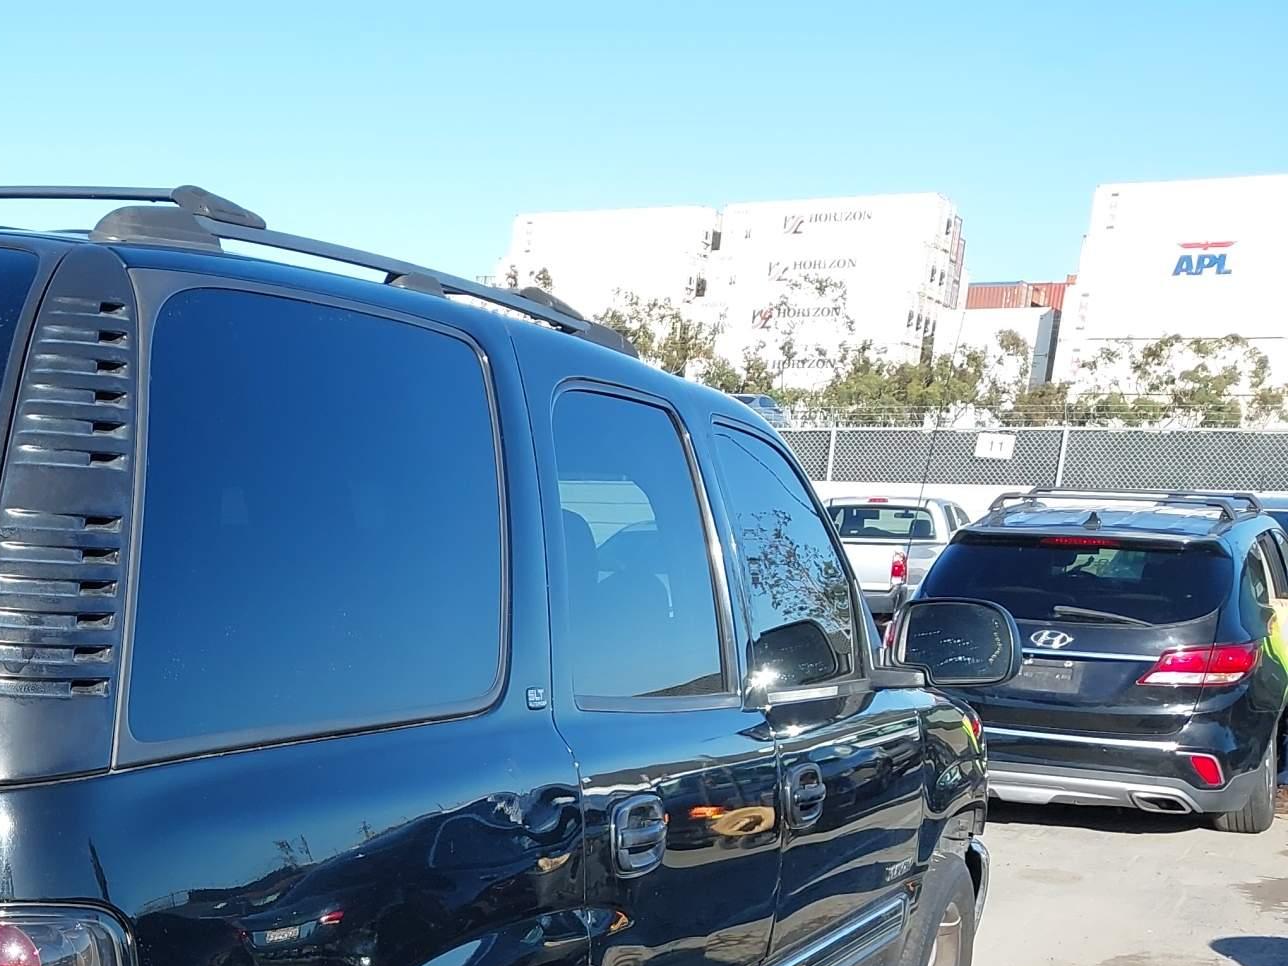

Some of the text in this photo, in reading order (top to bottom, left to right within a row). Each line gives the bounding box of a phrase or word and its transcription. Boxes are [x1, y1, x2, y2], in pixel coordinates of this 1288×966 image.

[809, 210, 873, 223] HORIZON
[793, 258, 857, 270] HORIZON
[1172, 254, 1232, 276] APL
[777, 306, 841, 318] HORIZON
